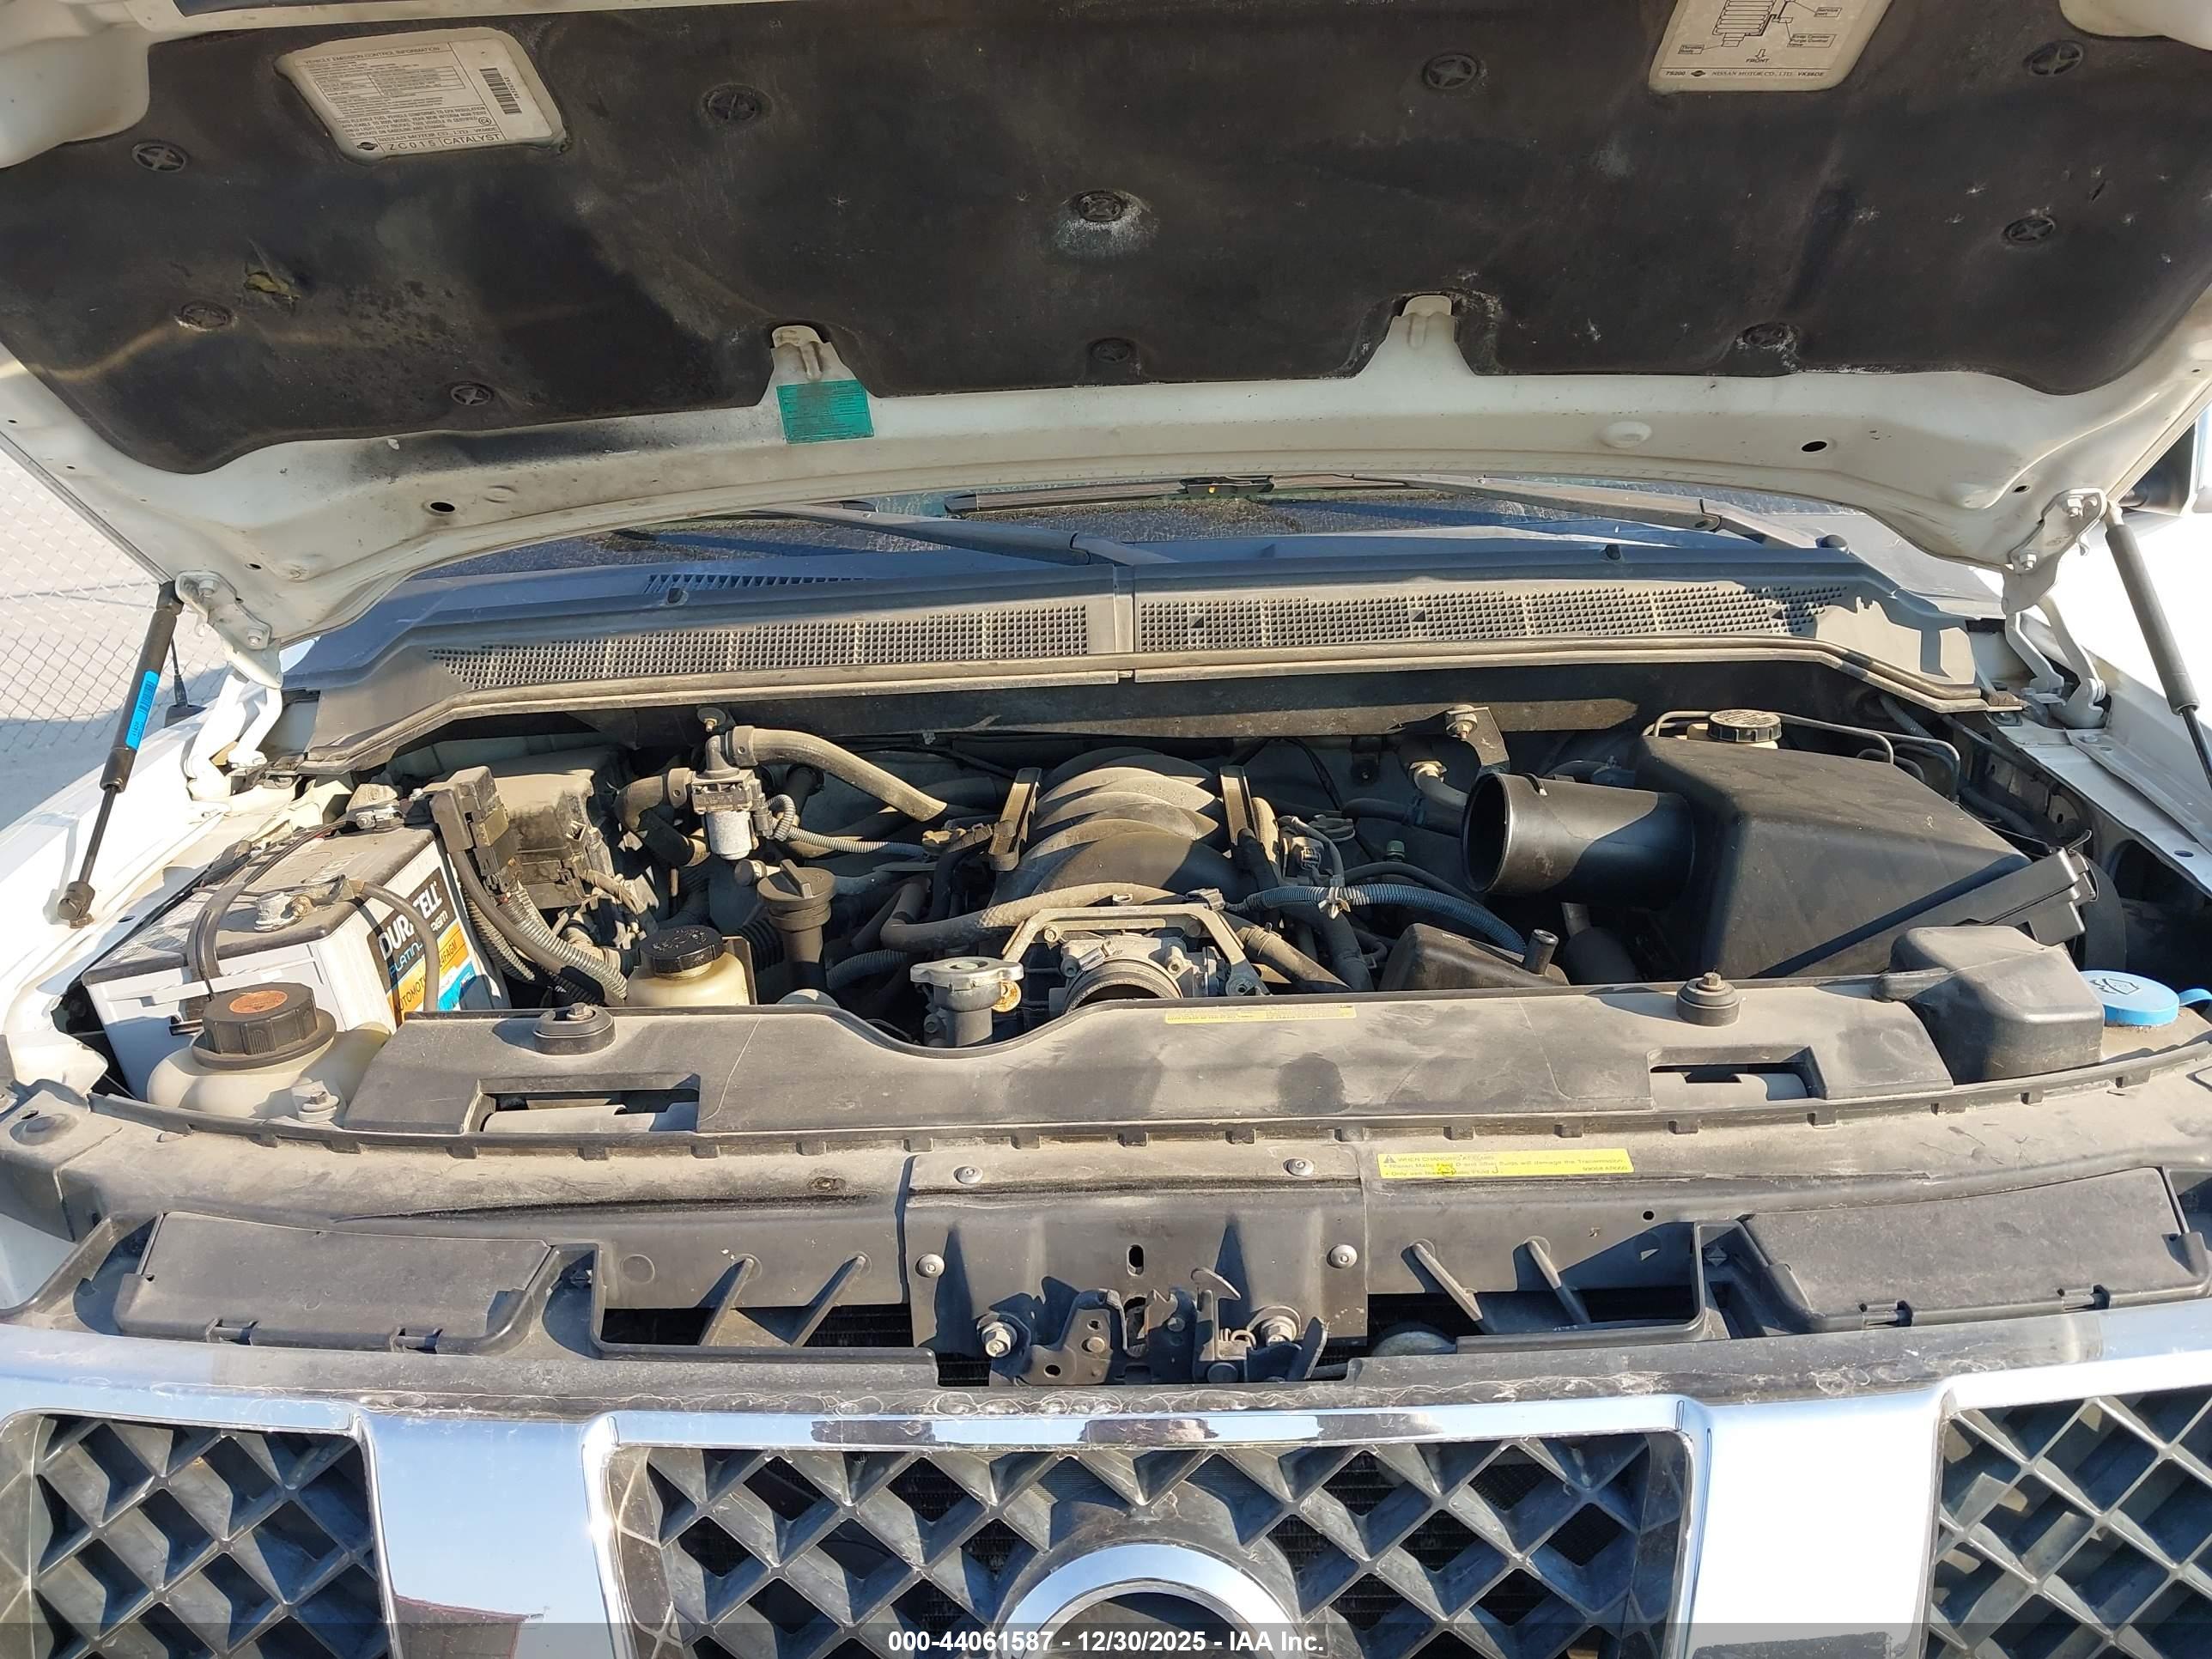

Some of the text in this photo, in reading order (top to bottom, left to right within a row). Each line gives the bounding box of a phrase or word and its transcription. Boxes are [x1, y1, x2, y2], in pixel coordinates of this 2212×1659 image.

[396, 46, 441, 55] INFORMATION
[388, 139, 436, 150] ZC015
[443, 133, 501, 146] CATALYST
[378, 882, 443, 961] DURELL
[389, 910, 448, 978] PLATIN AGM
